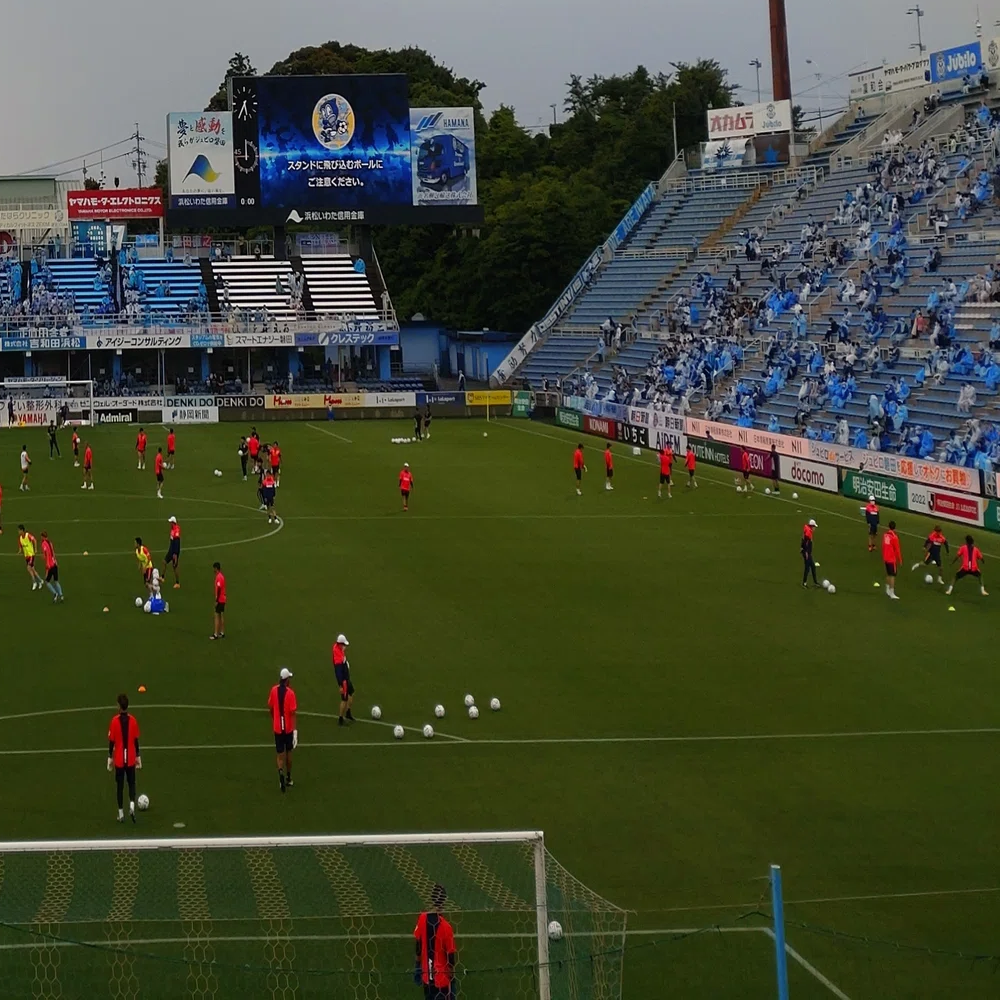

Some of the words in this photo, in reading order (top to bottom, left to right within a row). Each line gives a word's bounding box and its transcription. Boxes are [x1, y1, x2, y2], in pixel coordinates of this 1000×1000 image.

[443, 118, 469, 127] HAMANA
[287, 159, 383, 170] スタンドに飛び込むボールに
[308, 178, 364, 187] ご注意ください。
[178, 197, 228, 206] 浜松いわた信用金庫
[304, 211, 364, 220] 浜松いわた信用金庫
[4, 340, 28, 348] 株式会社
[105, 336, 182, 347] アイジーコンサルティング
[330, 333, 374, 344] クレステック
[167, 398, 196, 407] DENKI
[199, 398, 213, 407] DO
[217, 398, 247, 407] DENKI
[250, 397, 263, 406] DO
[18, 413, 47, 424] YAMAHA
[100, 412, 132, 423] Admiral
[588, 418, 609, 434] KONAMI
[623, 423, 645, 445] いちご
[791, 461, 824, 486] docomo
[852, 475, 897, 502] 明治安田生命
[911, 492, 926, 505] 2022
